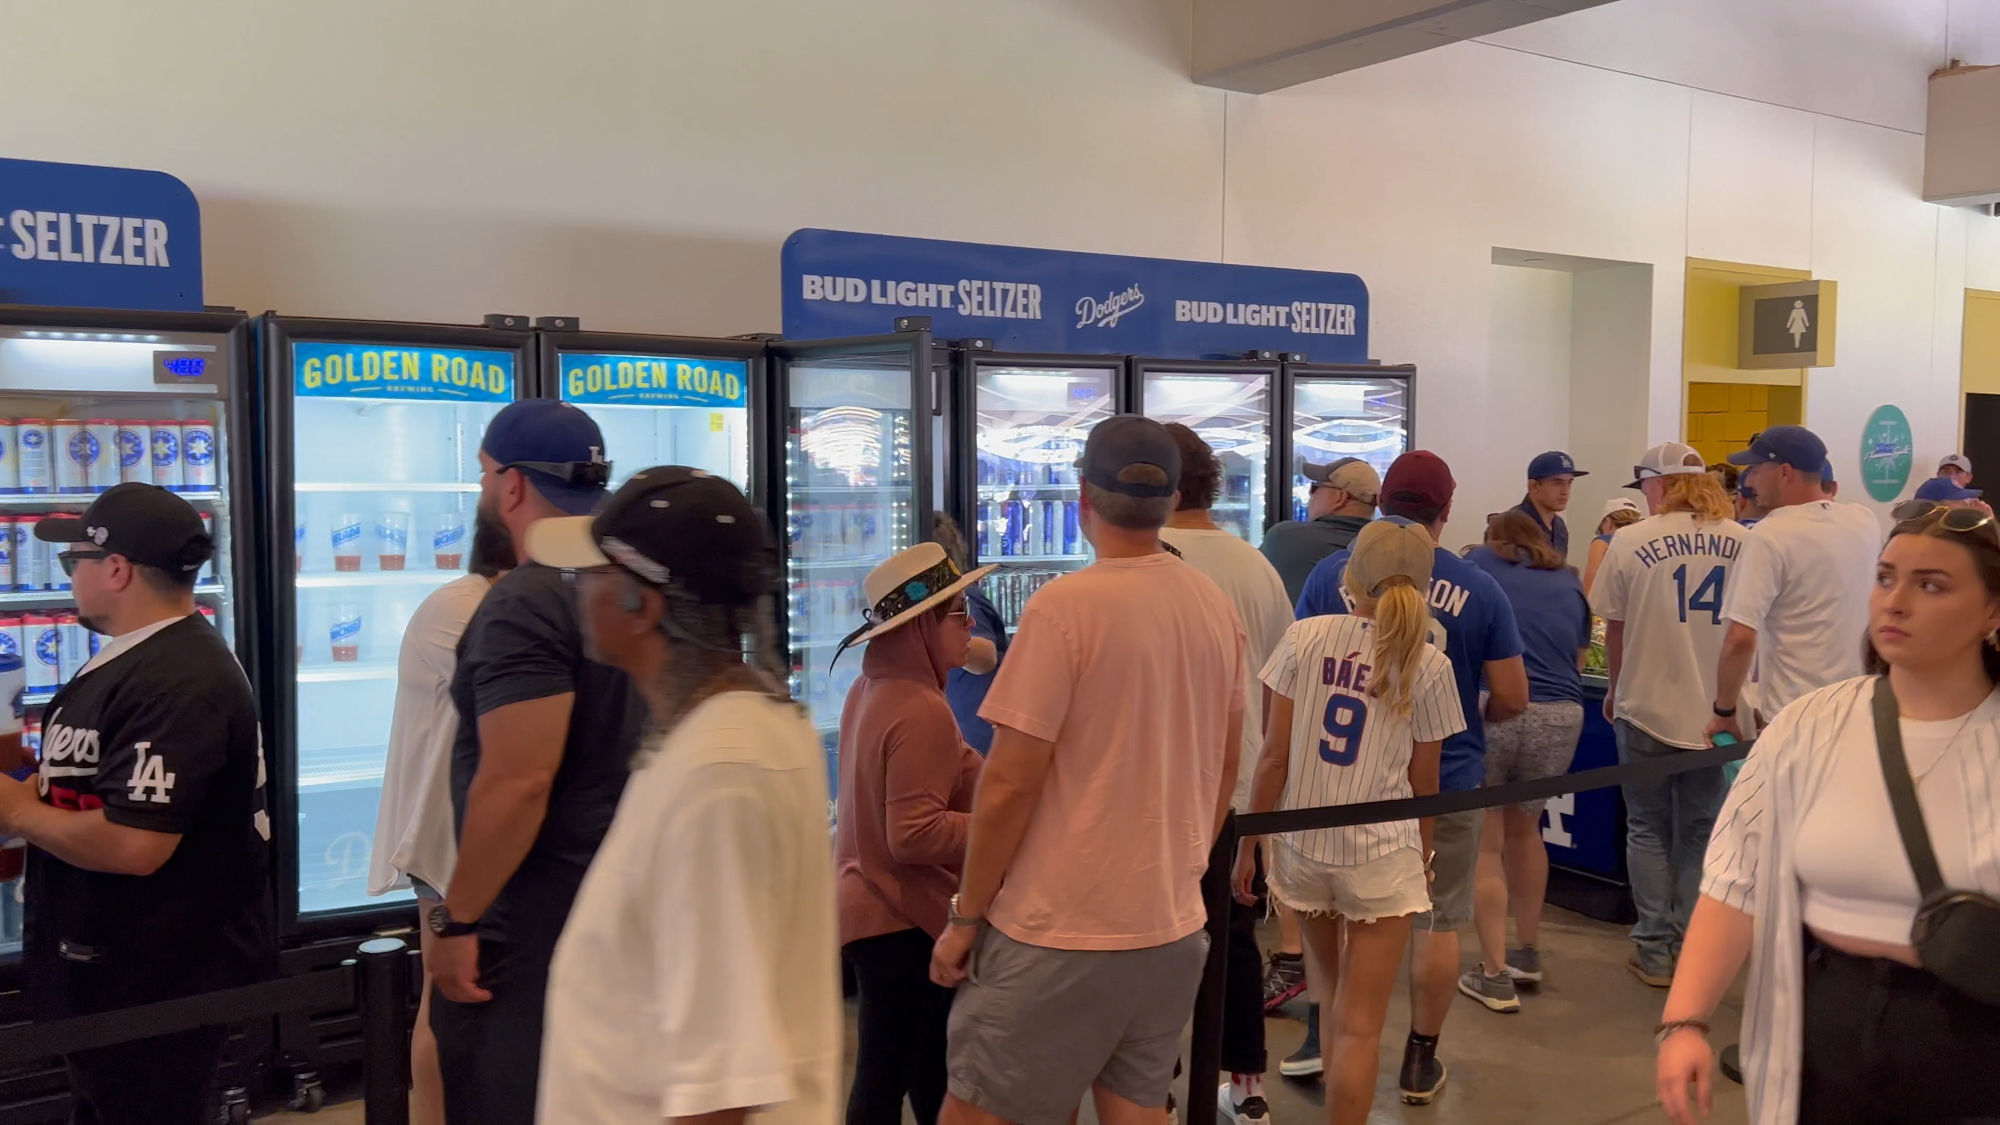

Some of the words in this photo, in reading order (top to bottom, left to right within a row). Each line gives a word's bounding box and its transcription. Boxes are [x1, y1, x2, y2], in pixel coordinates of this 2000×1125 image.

[10, 209, 170, 268] SELTZER
[802, 274, 867, 302] BUD
[871, 279, 955, 309] LIGHT
[958, 278, 1042, 320] SELTZER
[1075, 283, 1145, 329] Dodgers
[1175, 300, 1224, 324] BUD
[1226, 304, 1289, 327] LIGHT
[1290, 301, 1356, 336] SELTZER
[303, 351, 420, 389] GOLDEN
[432, 354, 506, 394] ROAD
[568, 361, 667, 396] GOLDEN
[677, 363, 740, 400] ROAD
[1672, 563, 1726, 625] 14
[1323, 652, 1378, 698] BÁE
[1319, 693, 1368, 767] 9
[126, 741, 176, 804] LA
